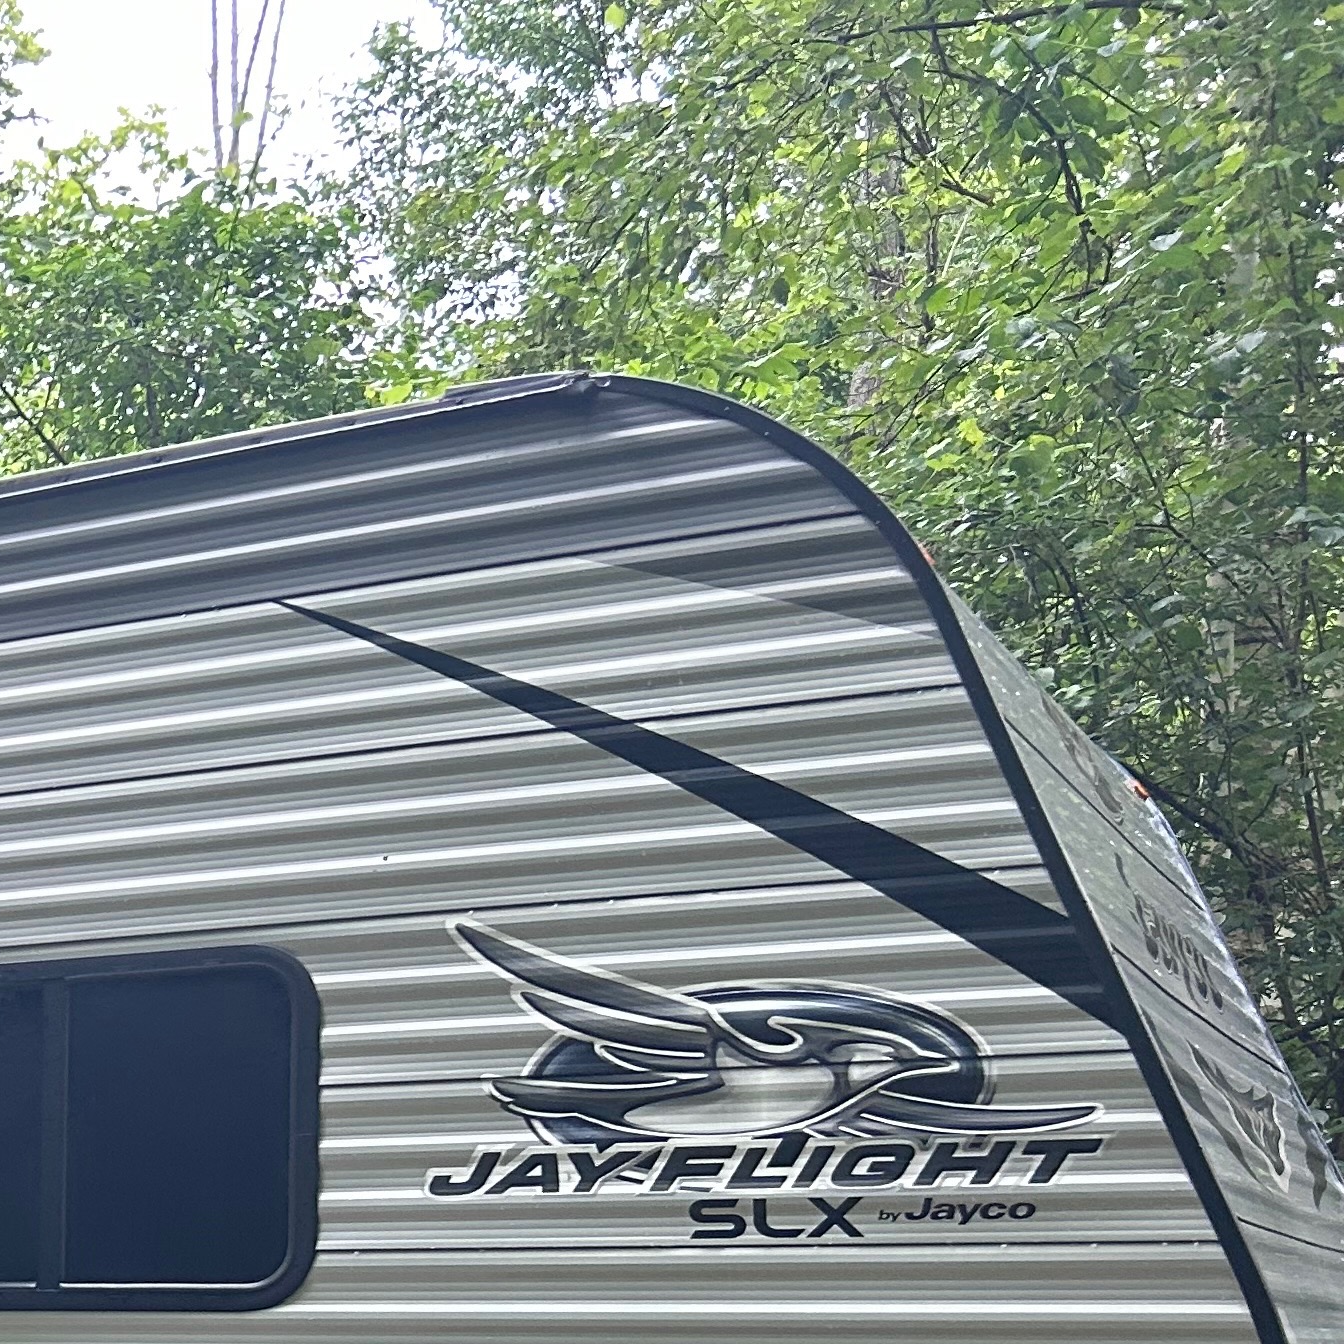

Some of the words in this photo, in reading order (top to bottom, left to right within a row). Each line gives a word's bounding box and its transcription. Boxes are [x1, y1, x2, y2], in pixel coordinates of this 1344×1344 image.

[426, 1146, 646, 1197] JAY
[649, 1138, 1104, 1191] FLIGHT
[688, 1196, 865, 1239] SLX
[877, 1207, 901, 1223] by
[904, 1196, 1037, 1226] Jayco
